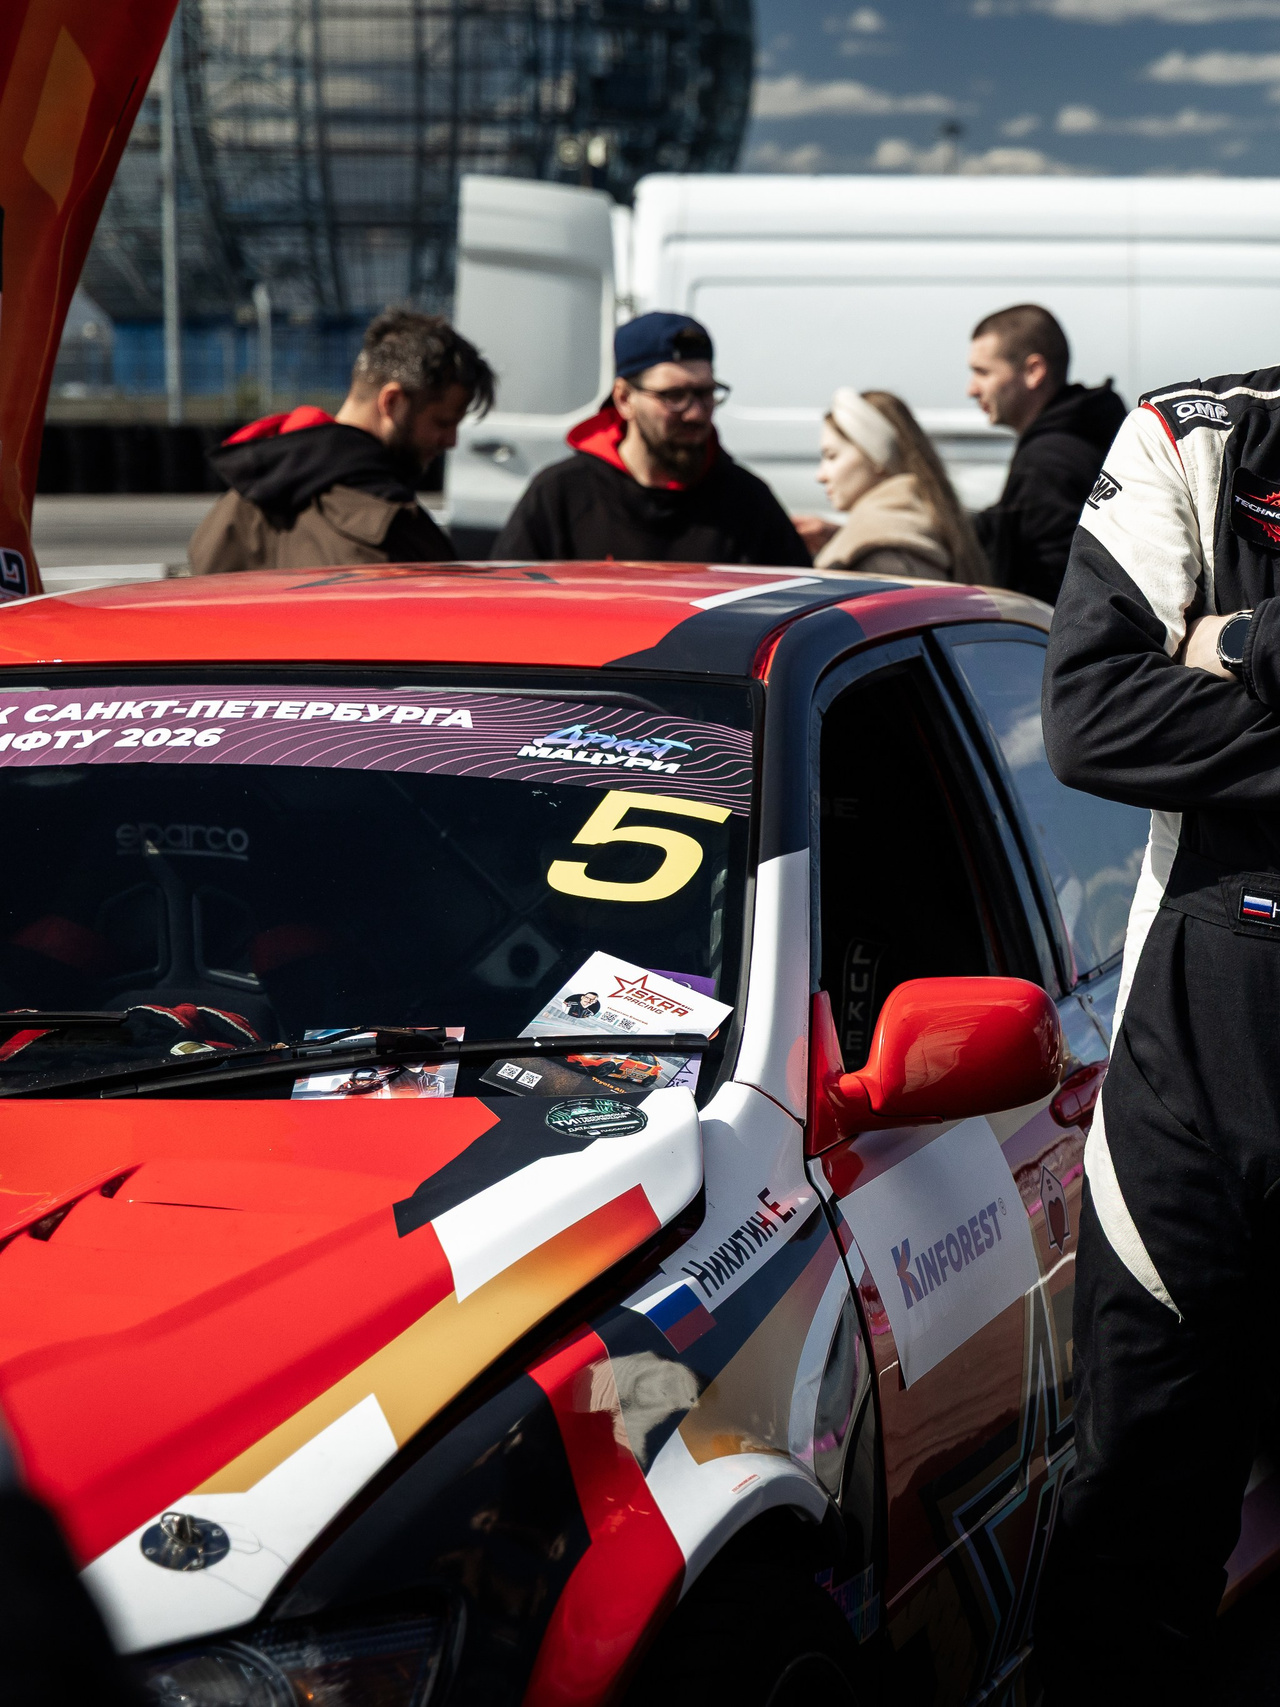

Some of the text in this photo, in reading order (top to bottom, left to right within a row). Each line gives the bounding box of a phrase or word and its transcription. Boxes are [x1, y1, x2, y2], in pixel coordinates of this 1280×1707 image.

[1176, 402, 1230, 420] OMP
[1090, 474, 1118, 502] MP
[24, 699, 474, 729] САНКТ-ПЕТЕРБУРГА
[113, 727, 226, 748] 2026
[516, 745, 681, 775] МАЦУРИ
[547, 790, 733, 902] 5
[623, 996, 664, 1015] RACING
[626, 988, 689, 1017] ISKRA
